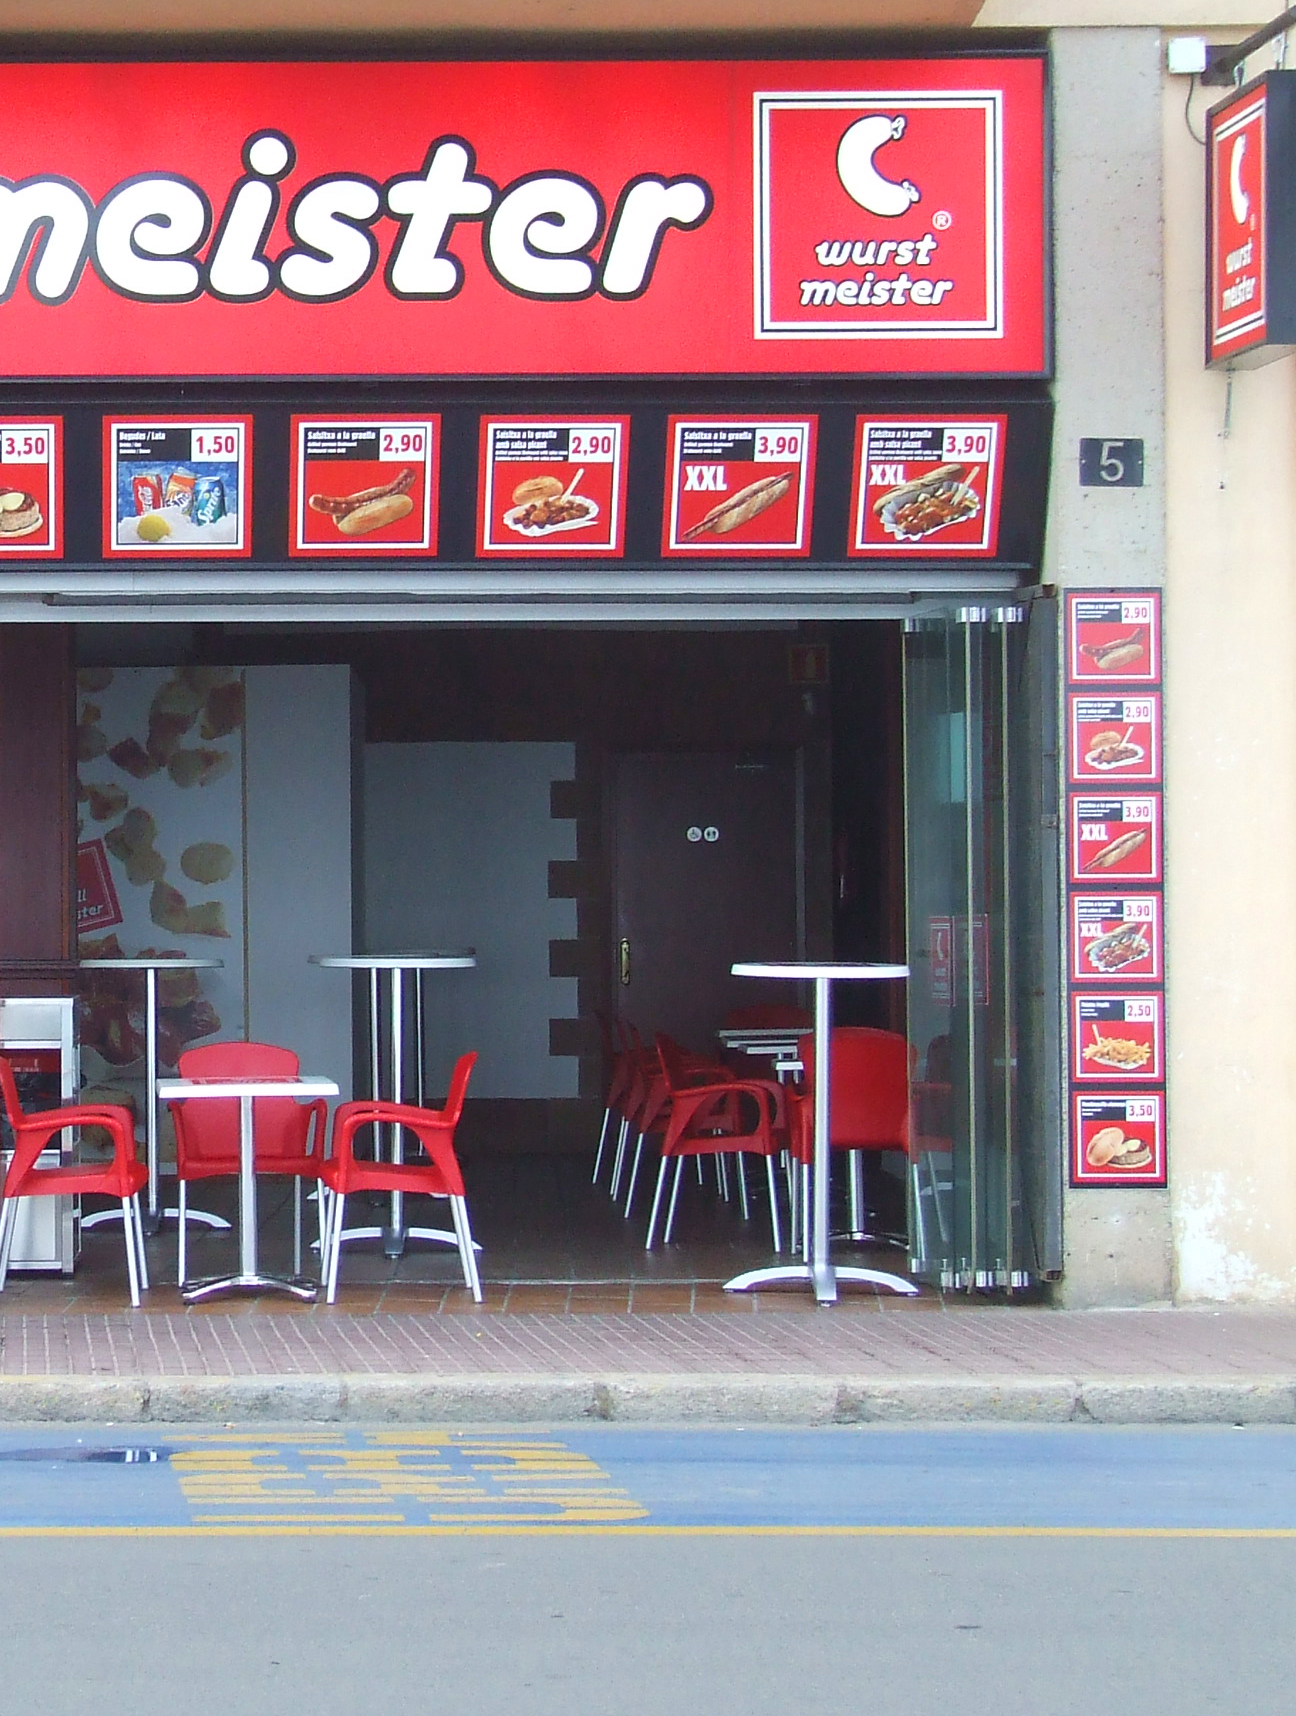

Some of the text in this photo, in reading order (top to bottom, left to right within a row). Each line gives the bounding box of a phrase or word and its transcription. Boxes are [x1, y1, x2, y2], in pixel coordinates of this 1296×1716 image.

[814, 233, 938, 266] wurst
[799, 271, 954, 306] meister
[5, 437, 45, 457] 3,50
[196, 435, 235, 456] 1,50
[383, 434, 423, 454] 2,90
[571, 436, 611, 456] 2,90
[758, 436, 798, 456] 3,90
[945, 435, 986, 456] 3,90
[1099, 441, 1124, 481] 5
[683, 465, 727, 491] XXL
[869, 464, 906, 486] XXL
[1080, 823, 1108, 841] XXL
